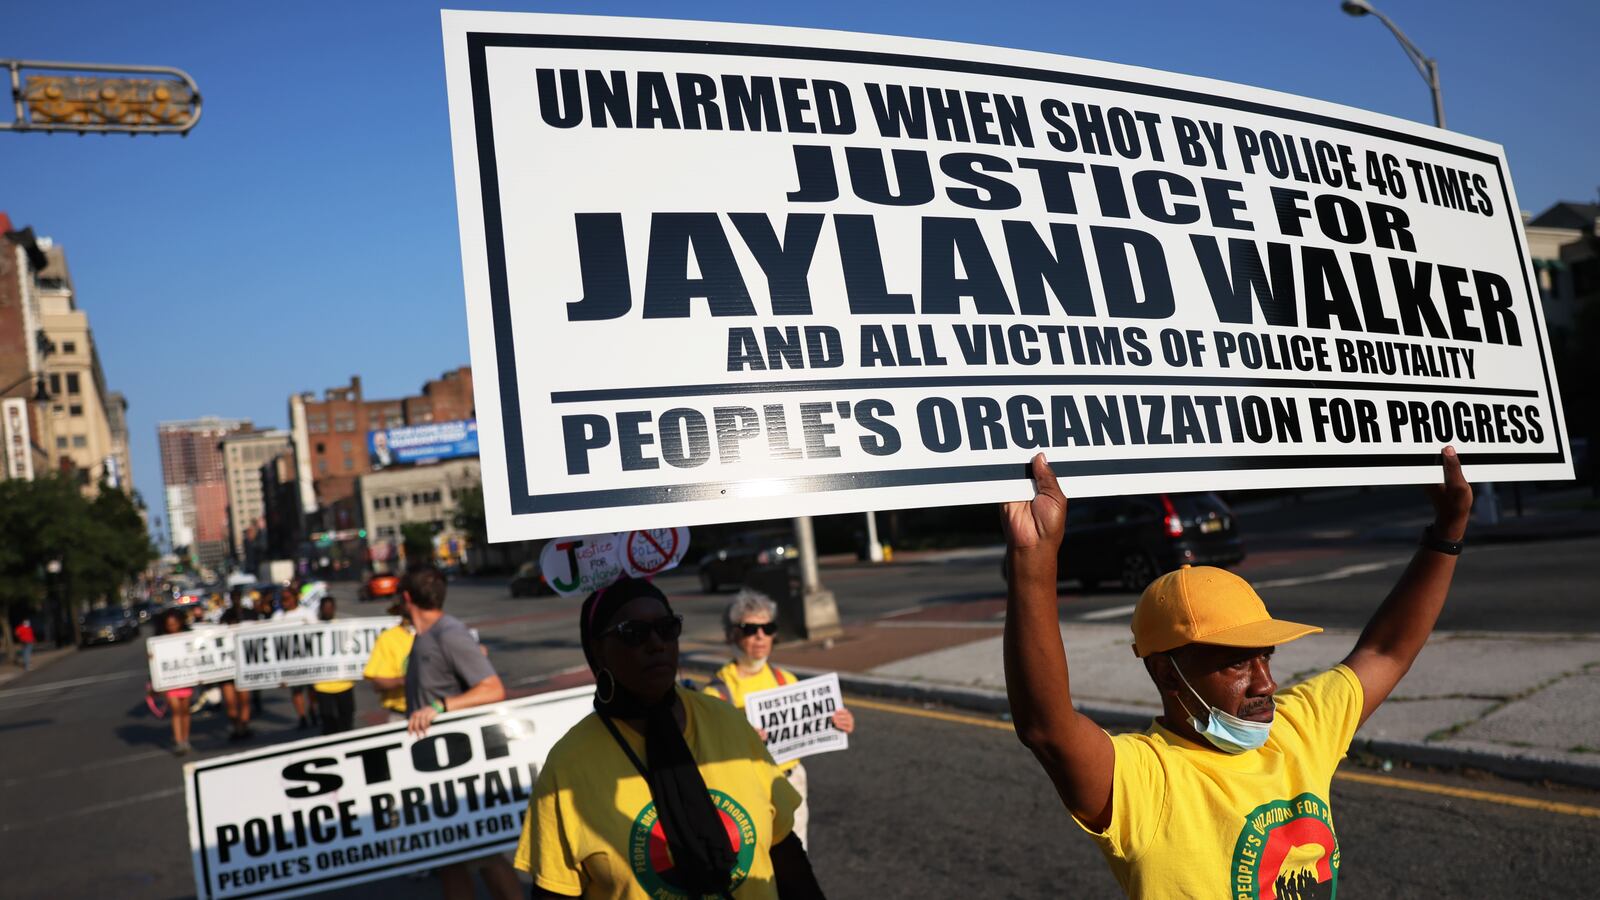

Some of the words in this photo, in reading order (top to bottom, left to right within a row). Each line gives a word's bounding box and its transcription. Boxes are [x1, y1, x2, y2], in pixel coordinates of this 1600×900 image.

[535, 68, 857, 135] UNARMED
[864, 82, 1034, 149] WHEN
[1041, 98, 1166, 162] SHOT
[1172, 115, 1228, 170] BY
[1233, 125, 1362, 190] POLICE
[1366, 149, 1402, 200] 46
[1406, 158, 1494, 217] TIMES
[786, 144, 1255, 232] JUSTICE
[1270, 186, 1417, 253] FOR
[565, 212, 1176, 322] JAYLAND
[1188, 233, 1522, 347] WALKER
[727, 325, 845, 372] AND
[860, 324, 947, 367] ALL
[952, 322, 1152, 367] VICTIMS
[1160, 327, 1206, 368] OF
[1214, 331, 1332, 372] POLICE
[1339, 337, 1476, 380] BRUTALITY
[561, 398, 903, 475] PEOPLE'S
[916, 394, 1301, 453] ORGANIZATION
[1308, 397, 1383, 443] FOR
[1387, 399, 1545, 444] PROGRESS
[242, 637, 270, 666] WE
[273, 631, 324, 661] WANT
[331, 627, 388, 656] JUST
[758, 691, 808, 711] JUSTICE
[811, 685, 831, 697] FOR
[760, 697, 836, 729] JAYLAND
[282, 720, 535, 799] STOP
[765, 716, 835, 745] WALKER
[215, 799, 361, 863] POLICE
[721, 799, 755, 845] PROGRESS
[1296, 797, 1320, 816] FOR
[218, 855, 311, 890] PEOPLE'S
[318, 821, 471, 872] ORGANIZATION
[476, 813, 514, 838] FOR
[1236, 834, 1262, 900] PEOPLE'S
